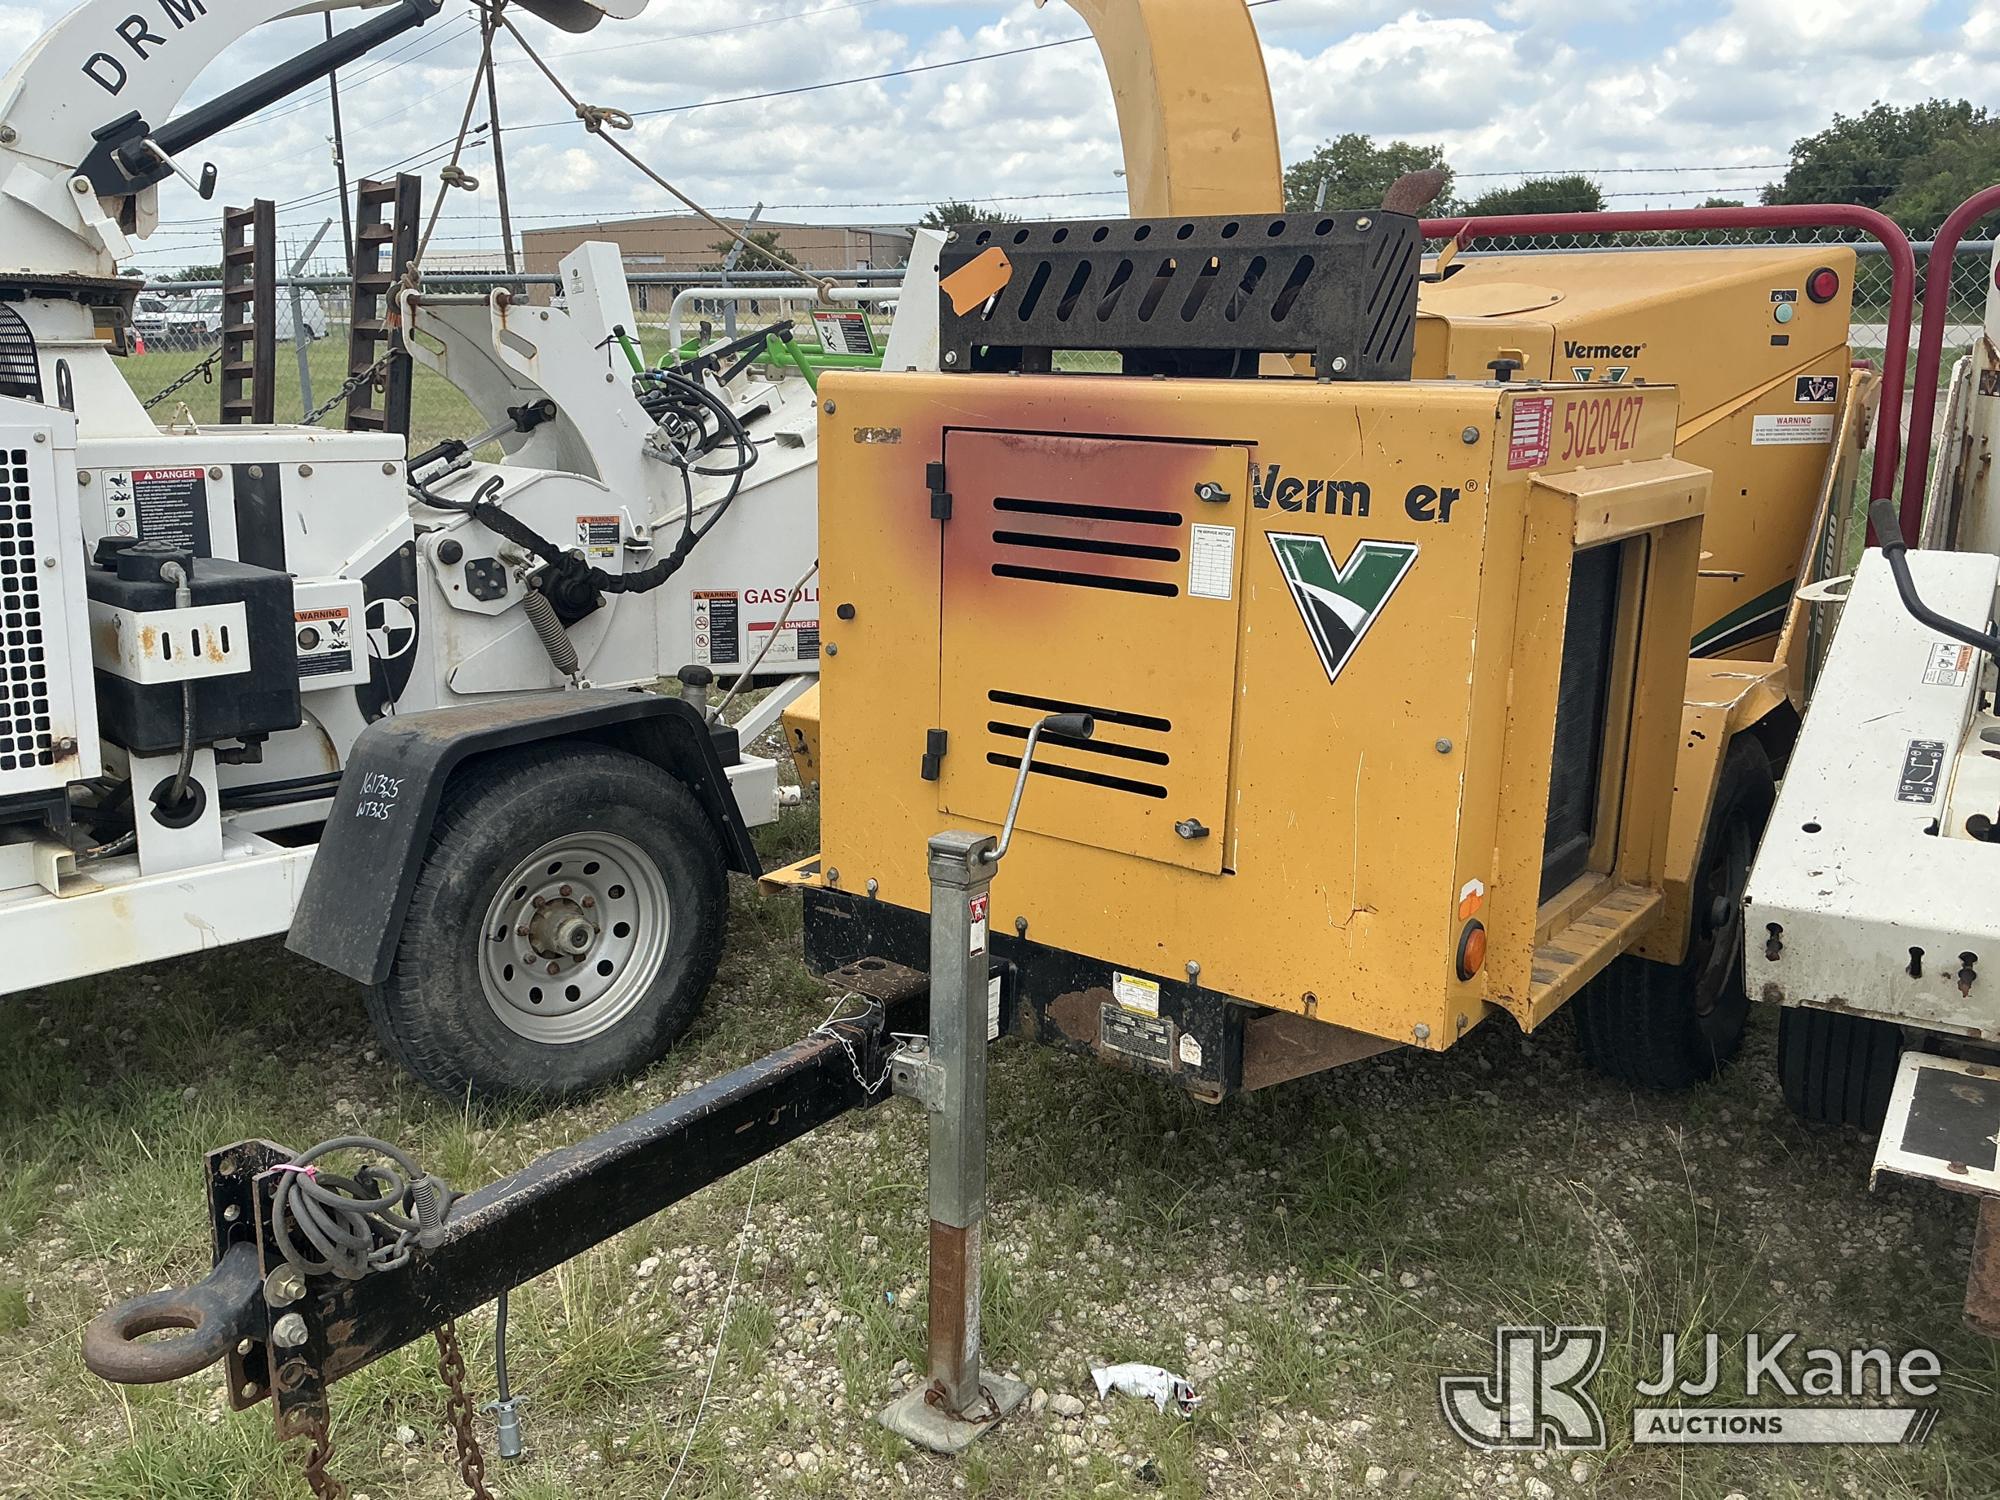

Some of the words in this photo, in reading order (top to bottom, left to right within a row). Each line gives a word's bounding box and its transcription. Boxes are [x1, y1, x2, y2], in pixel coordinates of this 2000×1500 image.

[82, 0, 208, 97] DRM
[1776, 416, 1812, 425] WARNING
[1561, 396, 1644, 461] 5020427
[155, 470, 196, 480] DANGER
[704, 591, 737, 599] WARNING
[299, 609, 342, 621] WARNING
[785, 621, 817, 630] DANGER
